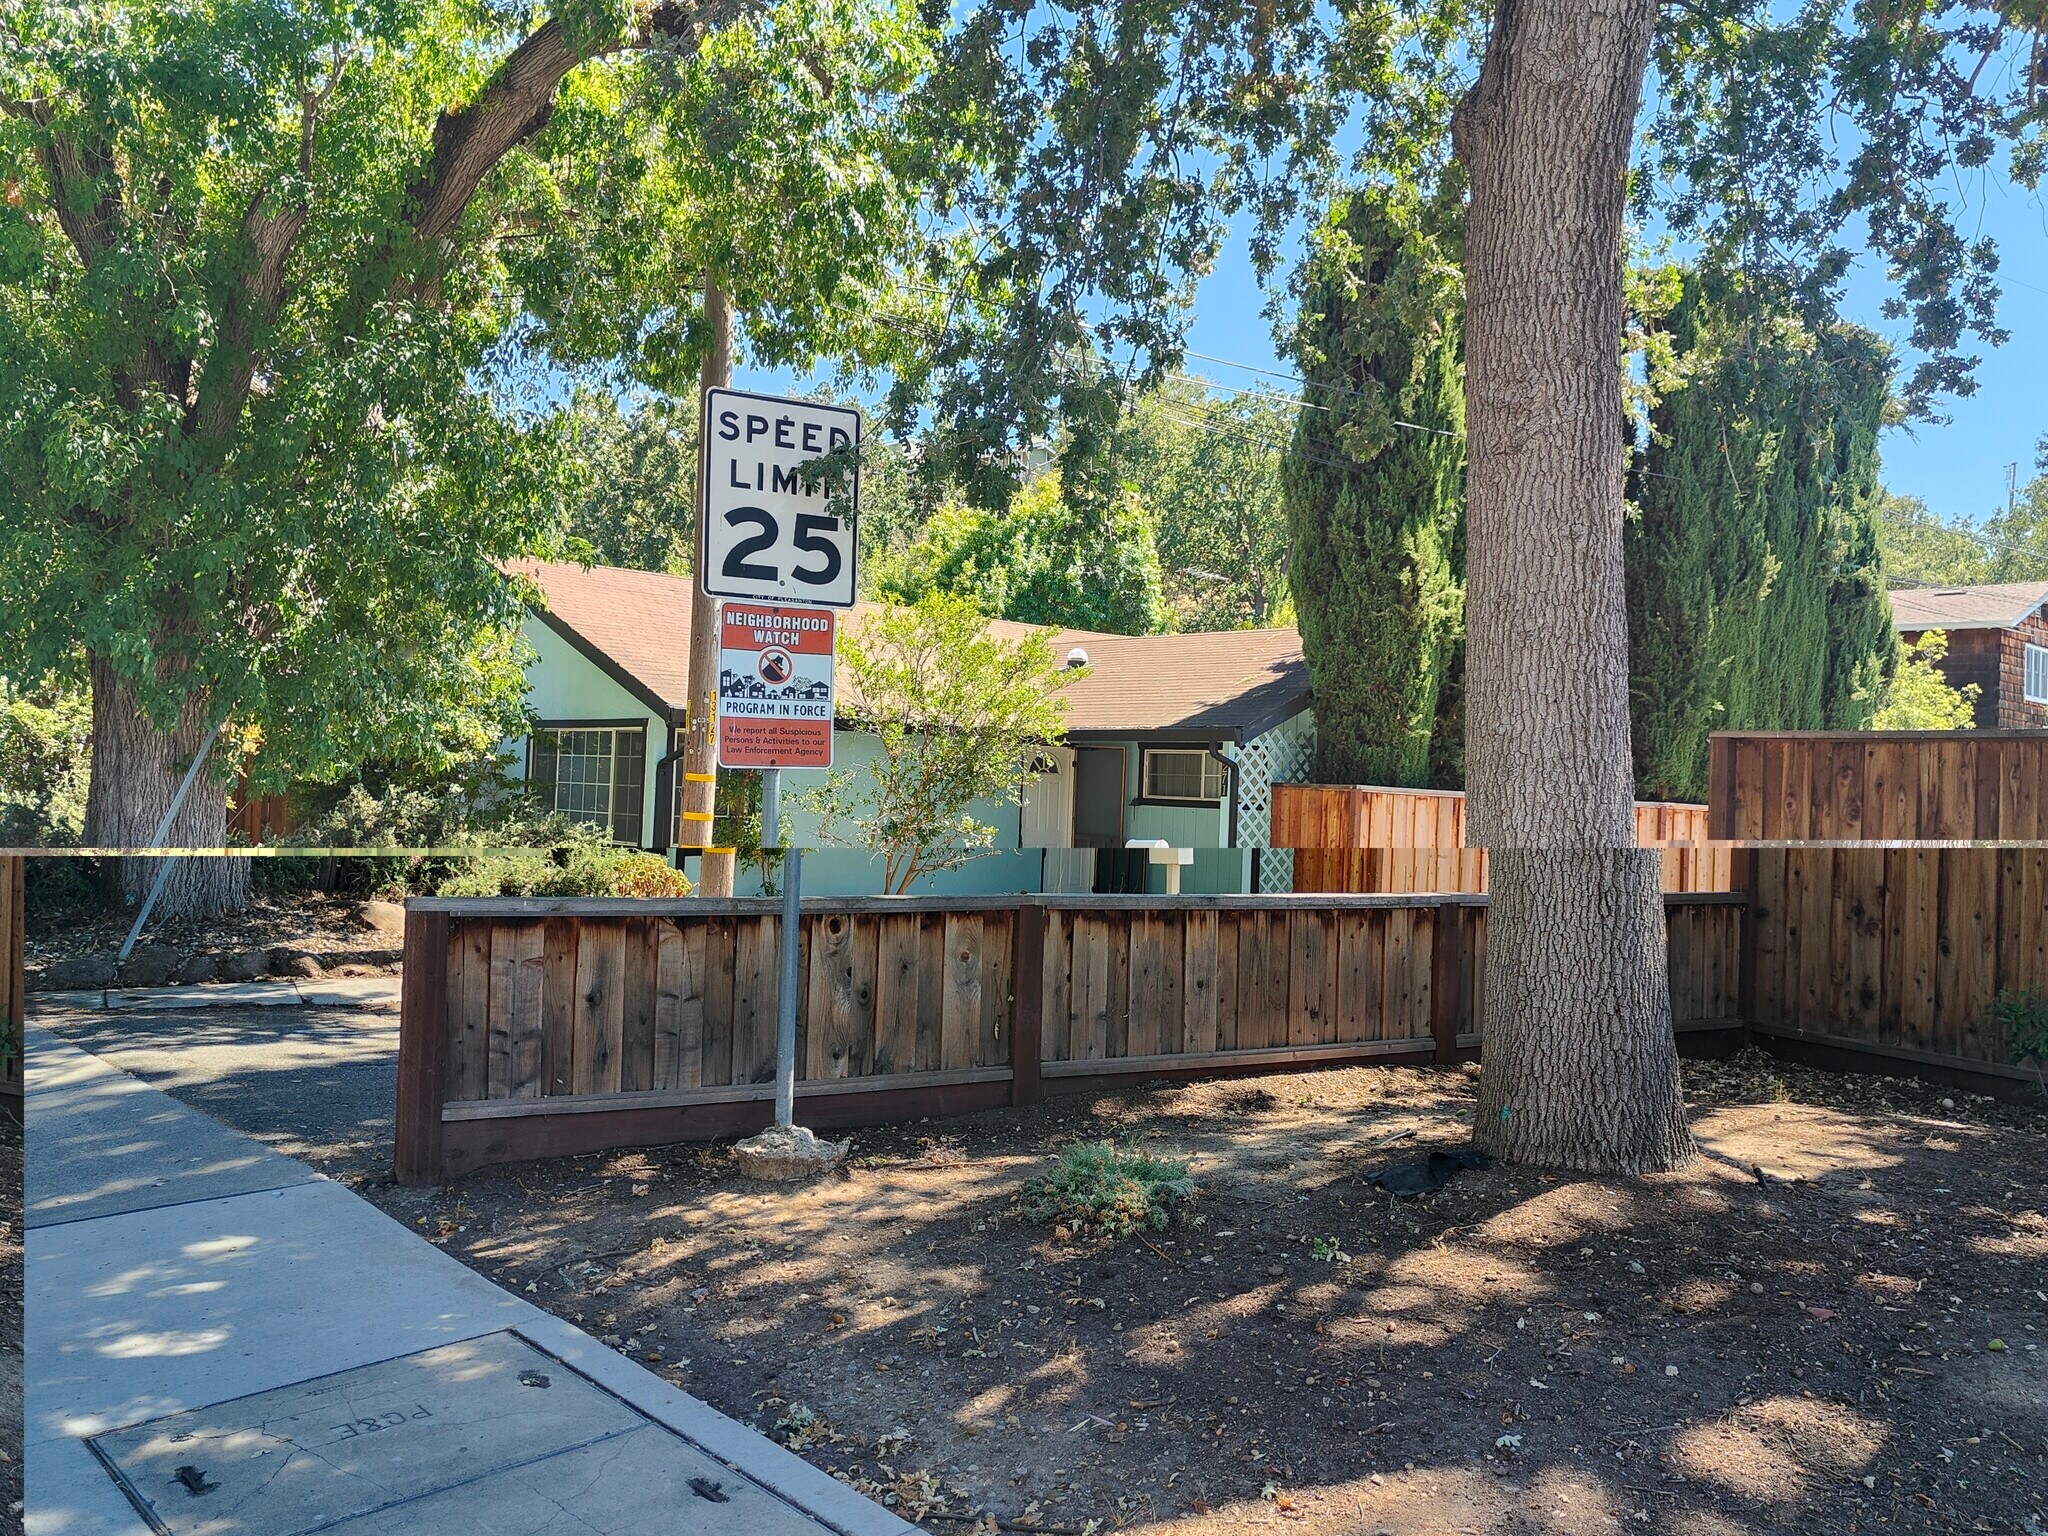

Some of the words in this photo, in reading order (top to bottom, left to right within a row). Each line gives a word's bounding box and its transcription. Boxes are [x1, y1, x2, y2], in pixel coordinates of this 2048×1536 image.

[718, 411, 851, 454] SPEED
[721, 506, 842, 585] 25
[726, 611, 829, 632] NEIGHBORHOOD
[753, 629, 800, 645] WATCH
[726, 701, 775, 715] PROGRAM
[779, 704, 790, 715] IN
[793, 704, 826, 717] FORCE
[728, 725, 741, 734] We
[743, 727, 767, 735] report
[768, 727, 778, 735] all
[779, 727, 822, 737] Suspicious
[724, 735, 754, 744] Persons
[755, 736, 761, 744] &
[762, 737, 800, 745] Activities
[801, 738, 810, 746] to
[726, 745, 743, 754] Law
[744, 746, 793, 755] Enforcement
[794, 749, 824, 757] Agency
[329, 1404, 433, 1440] PG&E
